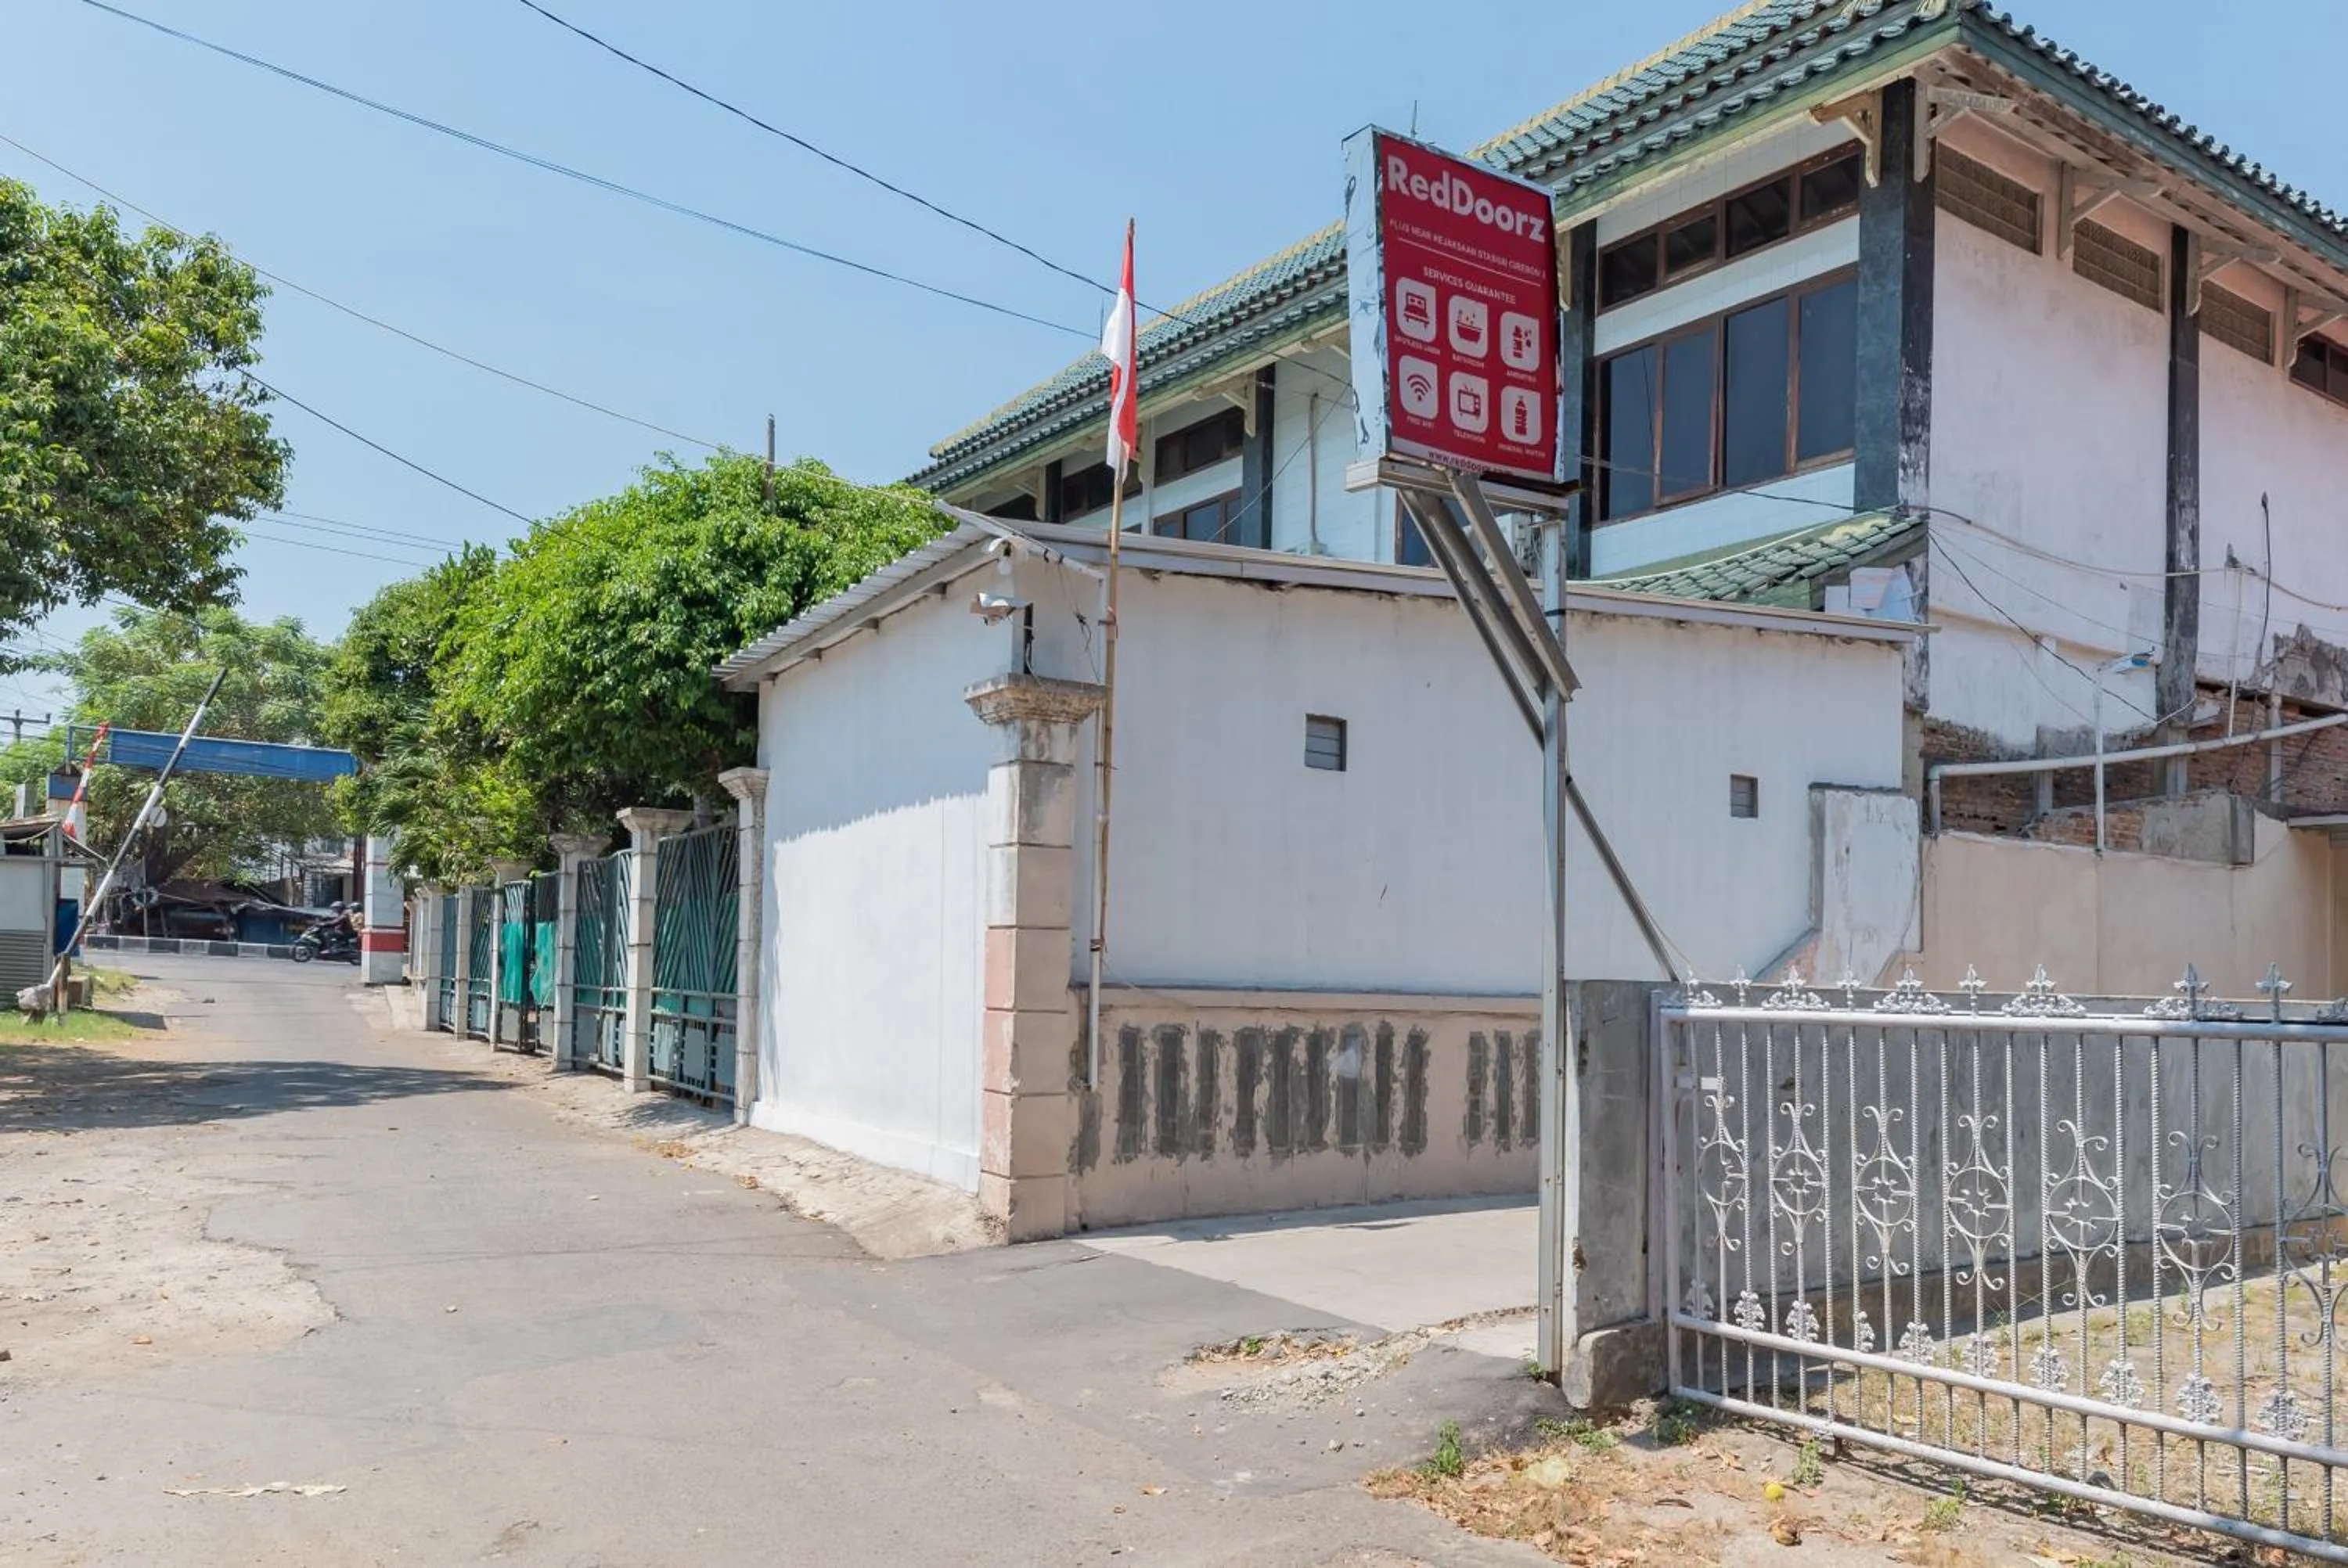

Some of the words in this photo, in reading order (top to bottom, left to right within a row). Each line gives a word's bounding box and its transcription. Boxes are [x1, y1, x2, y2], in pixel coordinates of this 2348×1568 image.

[1387, 154, 1545, 243] RedDoorz
[1411, 225, 1431, 241] NEAR
[1423, 265, 1464, 289] SERVICES
[1464, 279, 1516, 304] GUARANTEE
